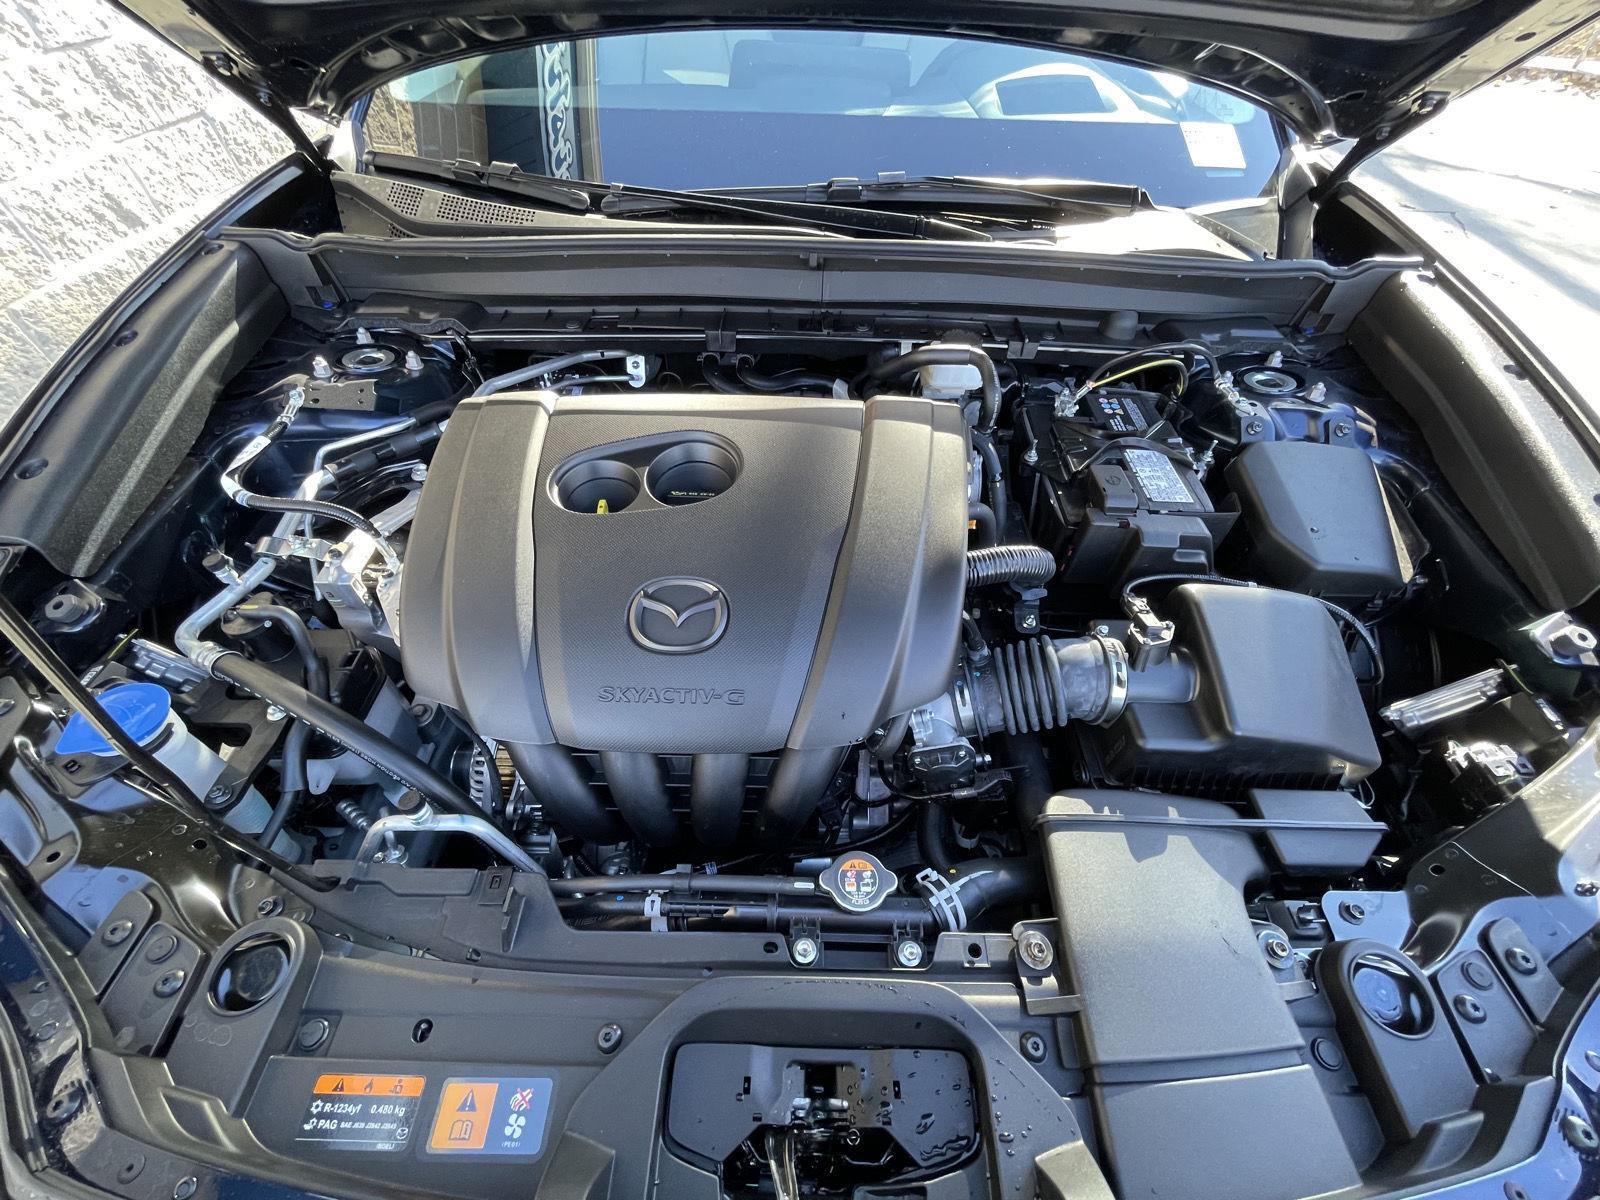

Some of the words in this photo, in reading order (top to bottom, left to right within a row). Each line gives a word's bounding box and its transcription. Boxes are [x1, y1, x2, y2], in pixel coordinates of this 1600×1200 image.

[598, 686, 745, 706] SKYACTIV-G
[323, 1103, 362, 1116] R-1234yf
[370, 1104, 393, 1114] 0.480
[394, 1104, 406, 1117] kg
[317, 1119, 338, 1130] PAG
